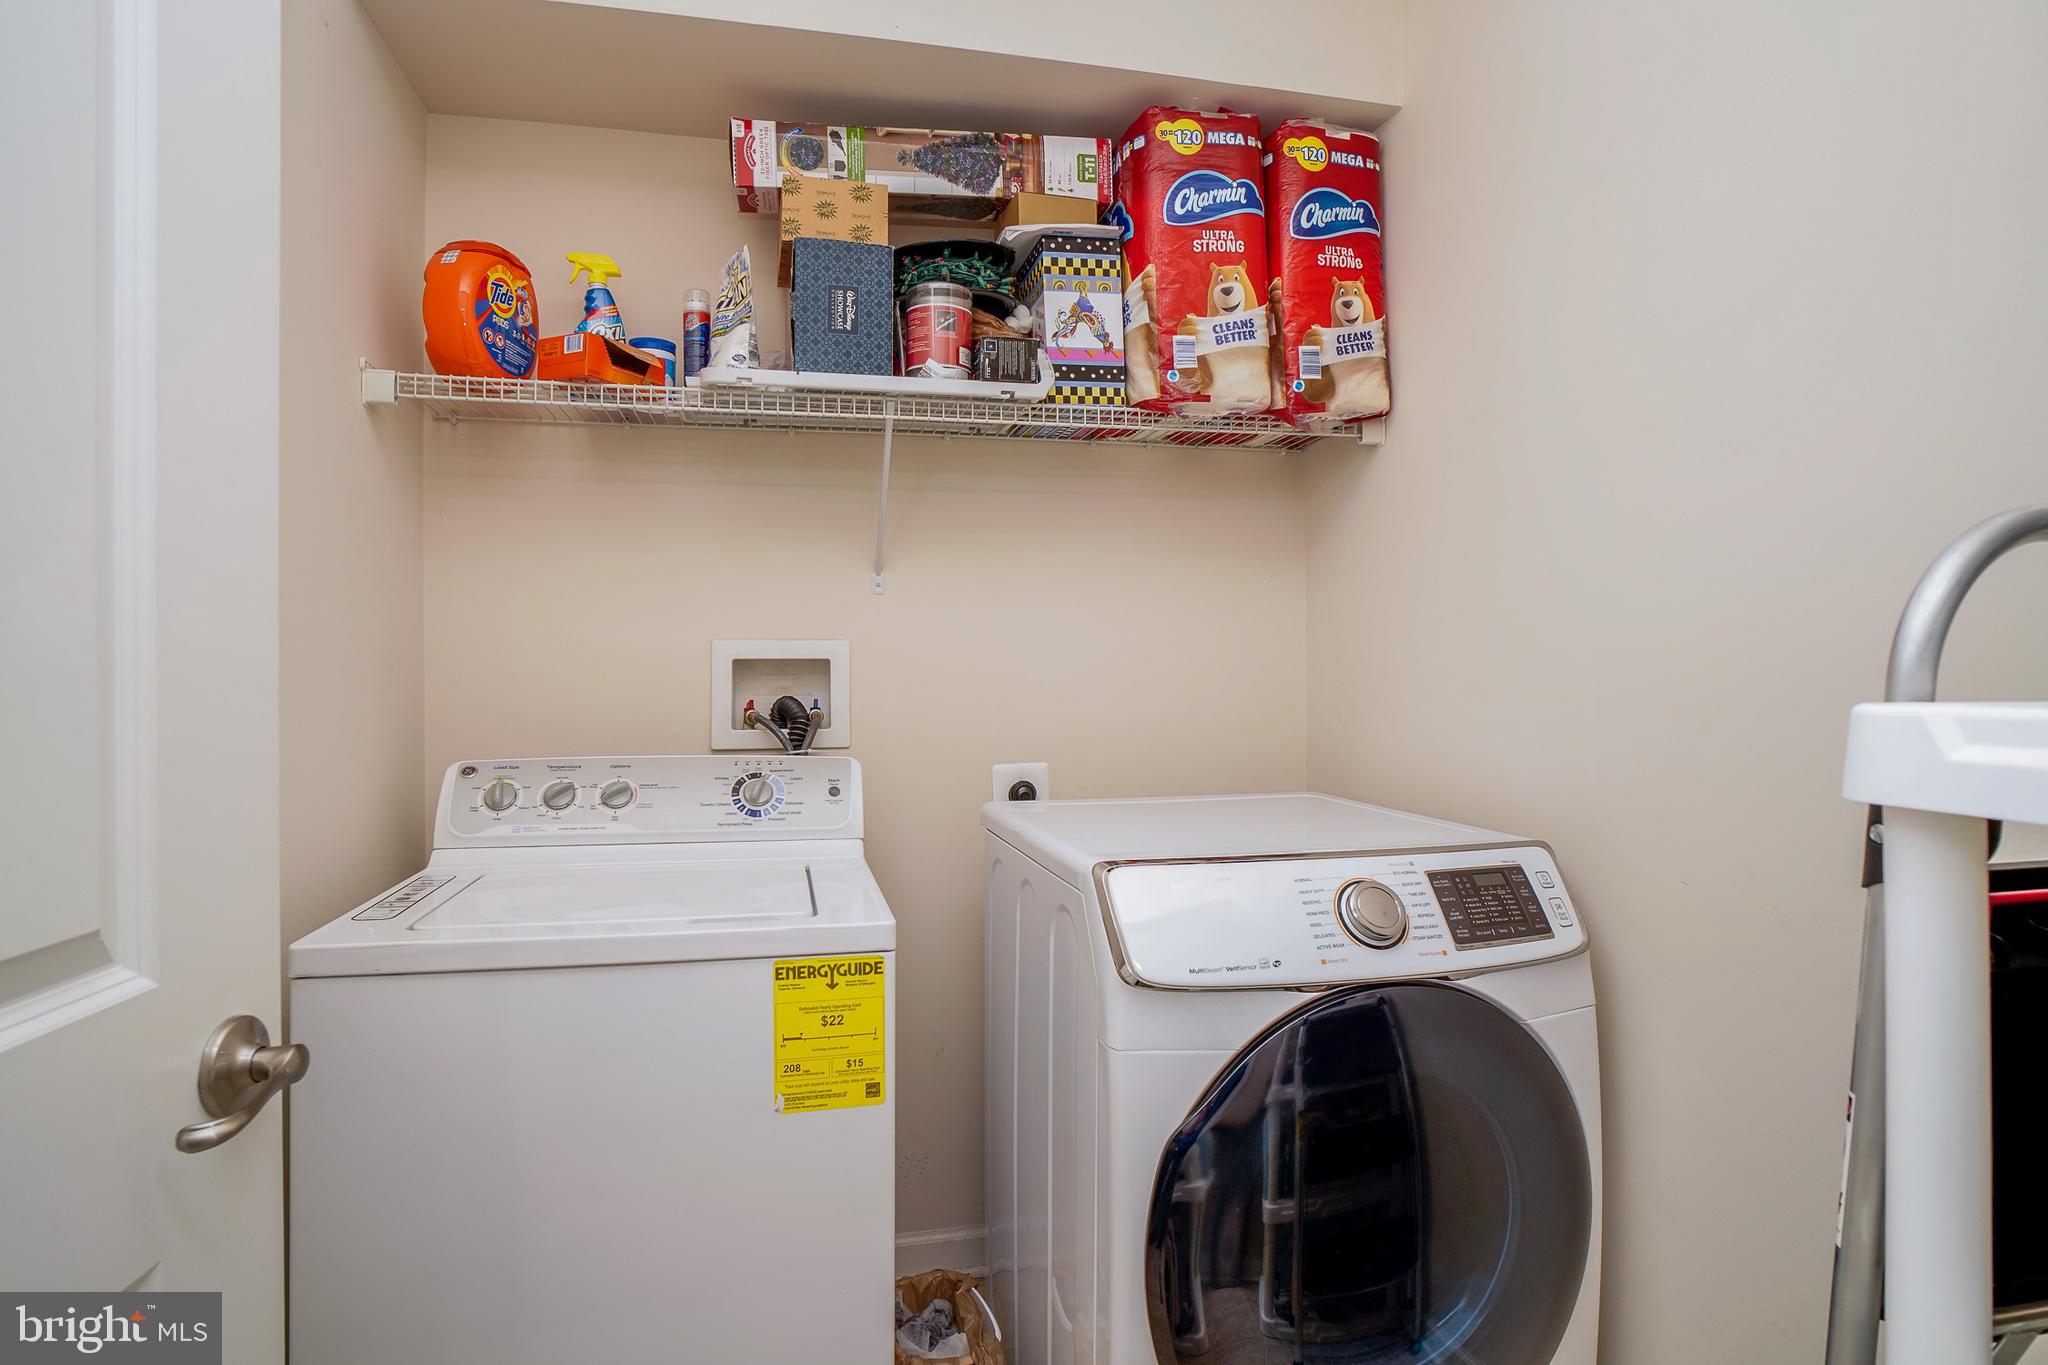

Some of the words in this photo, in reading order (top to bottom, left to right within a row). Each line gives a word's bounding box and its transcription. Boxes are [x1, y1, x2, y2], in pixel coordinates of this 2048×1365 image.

[1174, 129, 1202, 145] 120
[1206, 131, 1246, 146] MEGA
[1301, 146, 1326, 162] 120
[1330, 151, 1364, 168] MEGA
[1084, 158, 1096, 180] T-11
[1174, 181, 1247, 215] Charmin
[1300, 202, 1364, 230] Charmin
[1202, 230, 1235, 240] ULTRA
[1192, 240, 1245, 253] STRONG
[1325, 245, 1354, 258] ULTRA
[1317, 254, 1364, 270] STRONG
[489, 280, 514, 308] Tide
[492, 314, 510, 330] PODS
[1212, 318, 1255, 334] CLEANS
[1336, 330, 1373, 344] CLEANS
[775, 961, 884, 982] ENERGYGUIDE
[821, 1015, 844, 1027] $22
[784, 1064, 801, 1073] 208
[846, 1059, 864, 1068] $15
